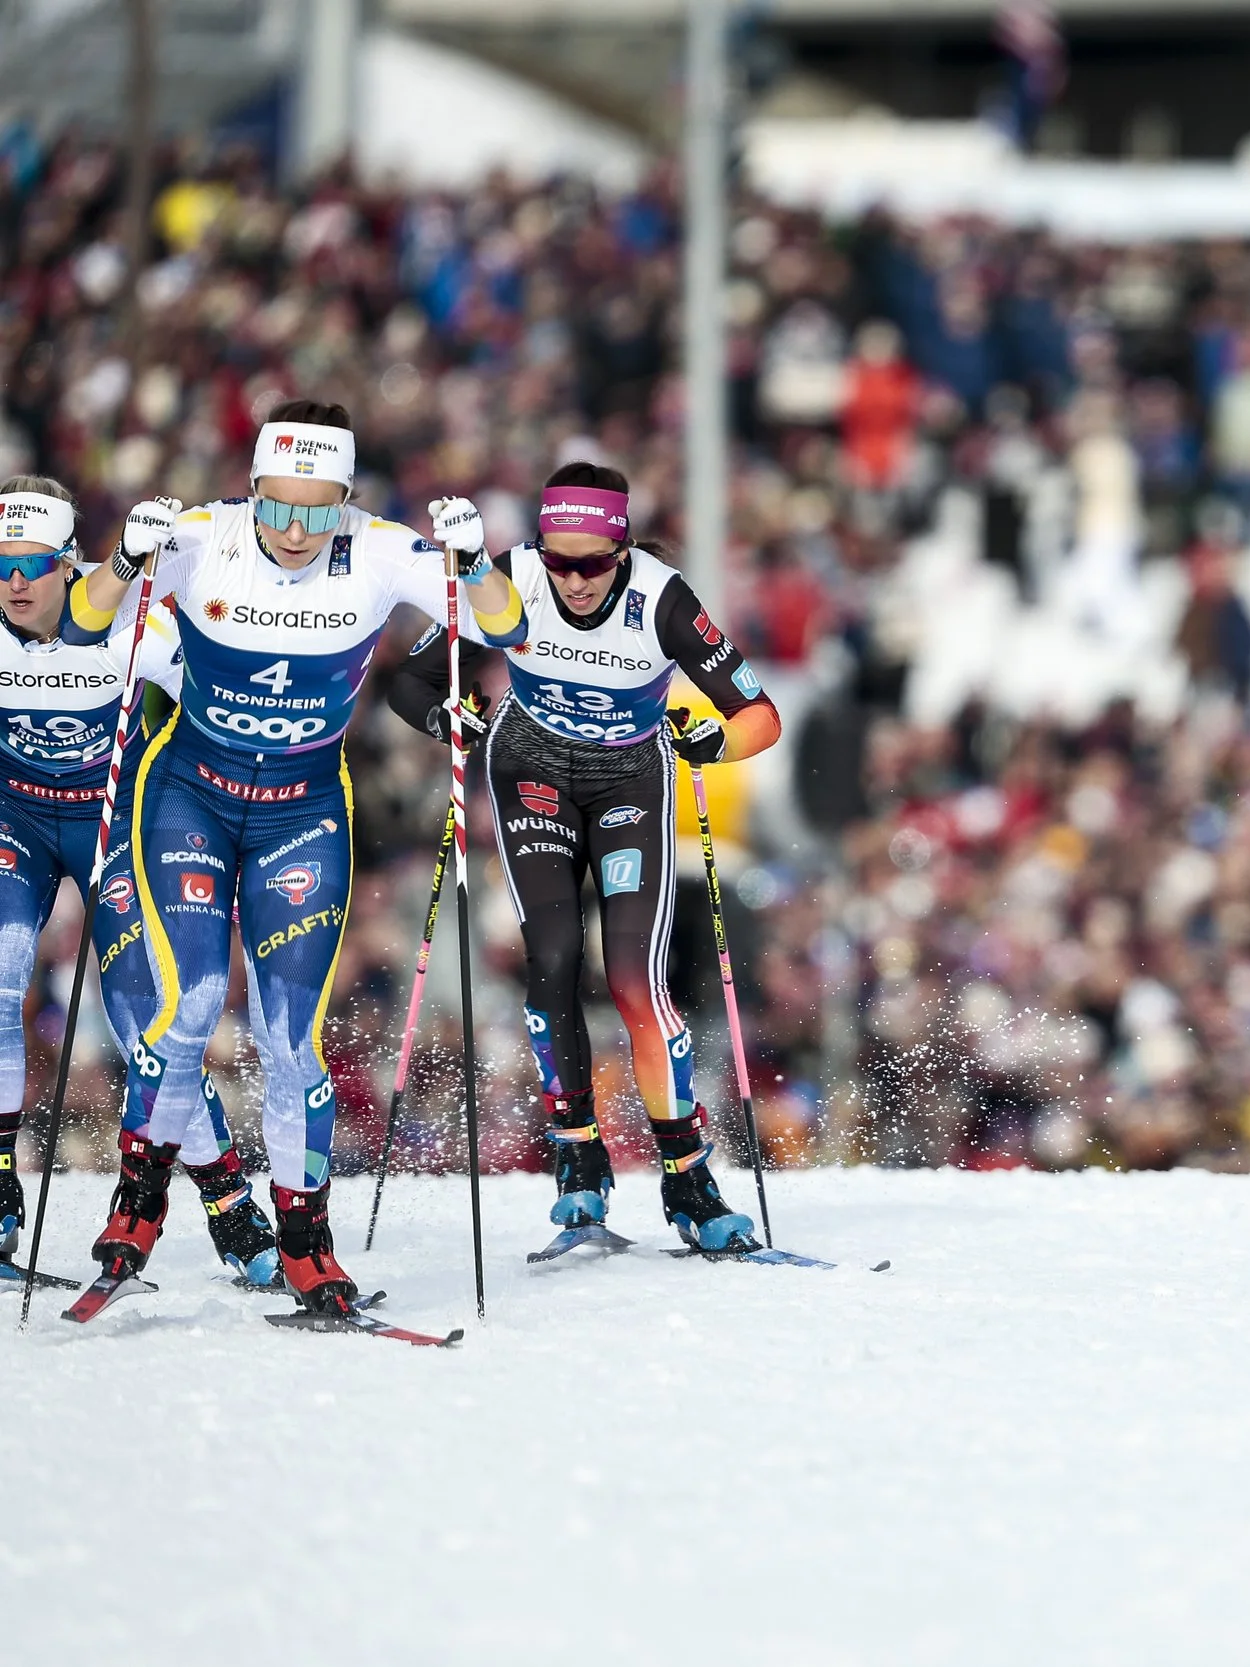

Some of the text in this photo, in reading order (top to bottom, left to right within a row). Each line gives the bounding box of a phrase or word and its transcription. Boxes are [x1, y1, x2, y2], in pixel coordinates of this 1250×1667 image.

[295, 446, 319, 456] SPEL
[297, 439, 338, 453] SVENSKA
[7, 511, 28, 519] SPEL
[8, 504, 48, 516] SVENSKA
[232, 605, 357, 628] StoraEnso
[536, 641, 652, 671] StoraEnso
[700, 637, 733, 673] WÜR
[0, 671, 118, 688] StoraEnso
[250, 660, 293, 694] 4
[212, 685, 326, 710] TRONDHEIM
[539, 684, 616, 711] 13
[8, 714, 88, 738] 19
[206, 706, 327, 744] coop
[603, 809, 637, 822] personal
[507, 816, 577, 843] WÜRTH
[258, 827, 323, 868] Sundström
[532, 842, 574, 859] TERREX
[161, 851, 226, 873] SCANIA
[267, 875, 306, 888] Thermia
[165, 905, 226, 919] SVENSKA SPEL
[257, 910, 330, 959] CRAFT
[101, 920, 143, 973] CRAF
